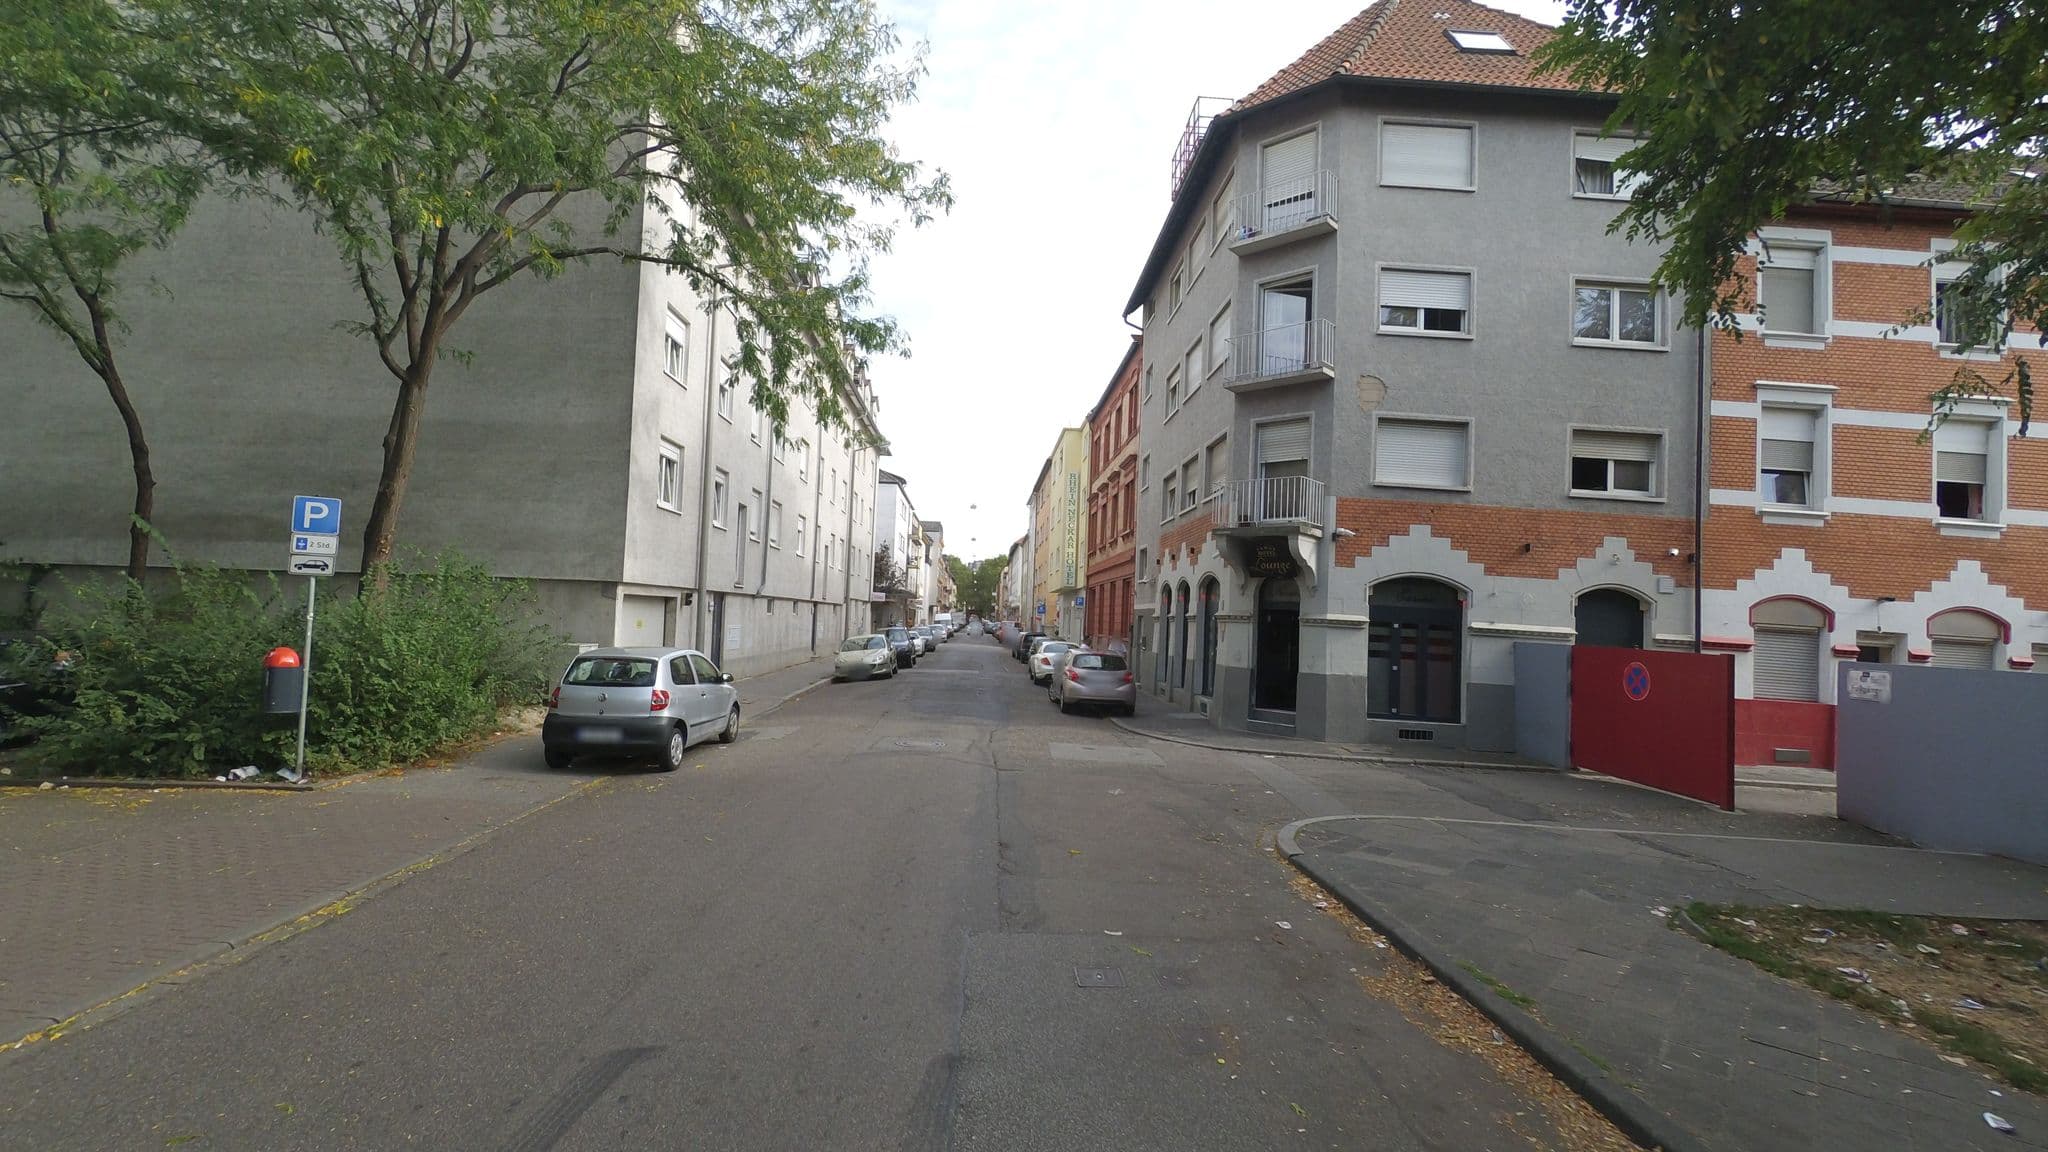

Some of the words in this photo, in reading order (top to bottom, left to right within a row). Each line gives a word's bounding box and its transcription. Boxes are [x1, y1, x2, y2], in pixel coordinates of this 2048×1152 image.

[1068, 473, 1076, 506] RHEIN
[303, 501, 329, 528] P
[1067, 509, 1076, 549] NECKAR
[1066, 552, 1075, 585] HOTEL
[1256, 557, 1290, 574] Lounge
